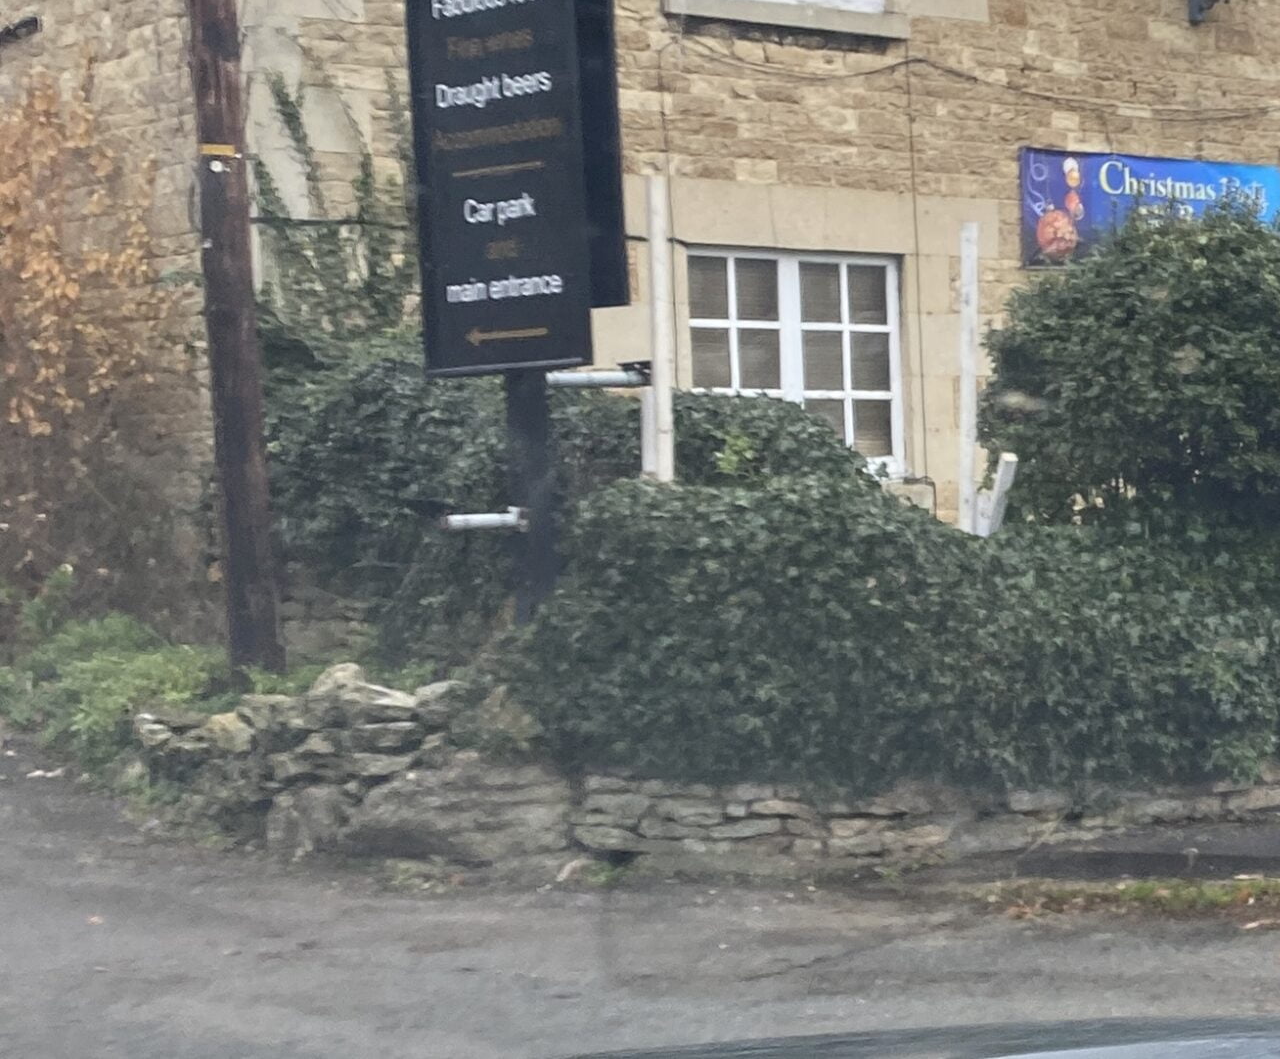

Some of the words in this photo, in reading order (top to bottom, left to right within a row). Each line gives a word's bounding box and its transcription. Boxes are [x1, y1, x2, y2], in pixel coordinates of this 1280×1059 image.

[435, 76, 502, 108] Draught
[501, 71, 552, 97] beers
[1099, 160, 1217, 200] Christmas
[464, 199, 495, 223] Car
[497, 192, 537, 226] park
[446, 277, 487, 303] main
[489, 274, 562, 299] entrance
